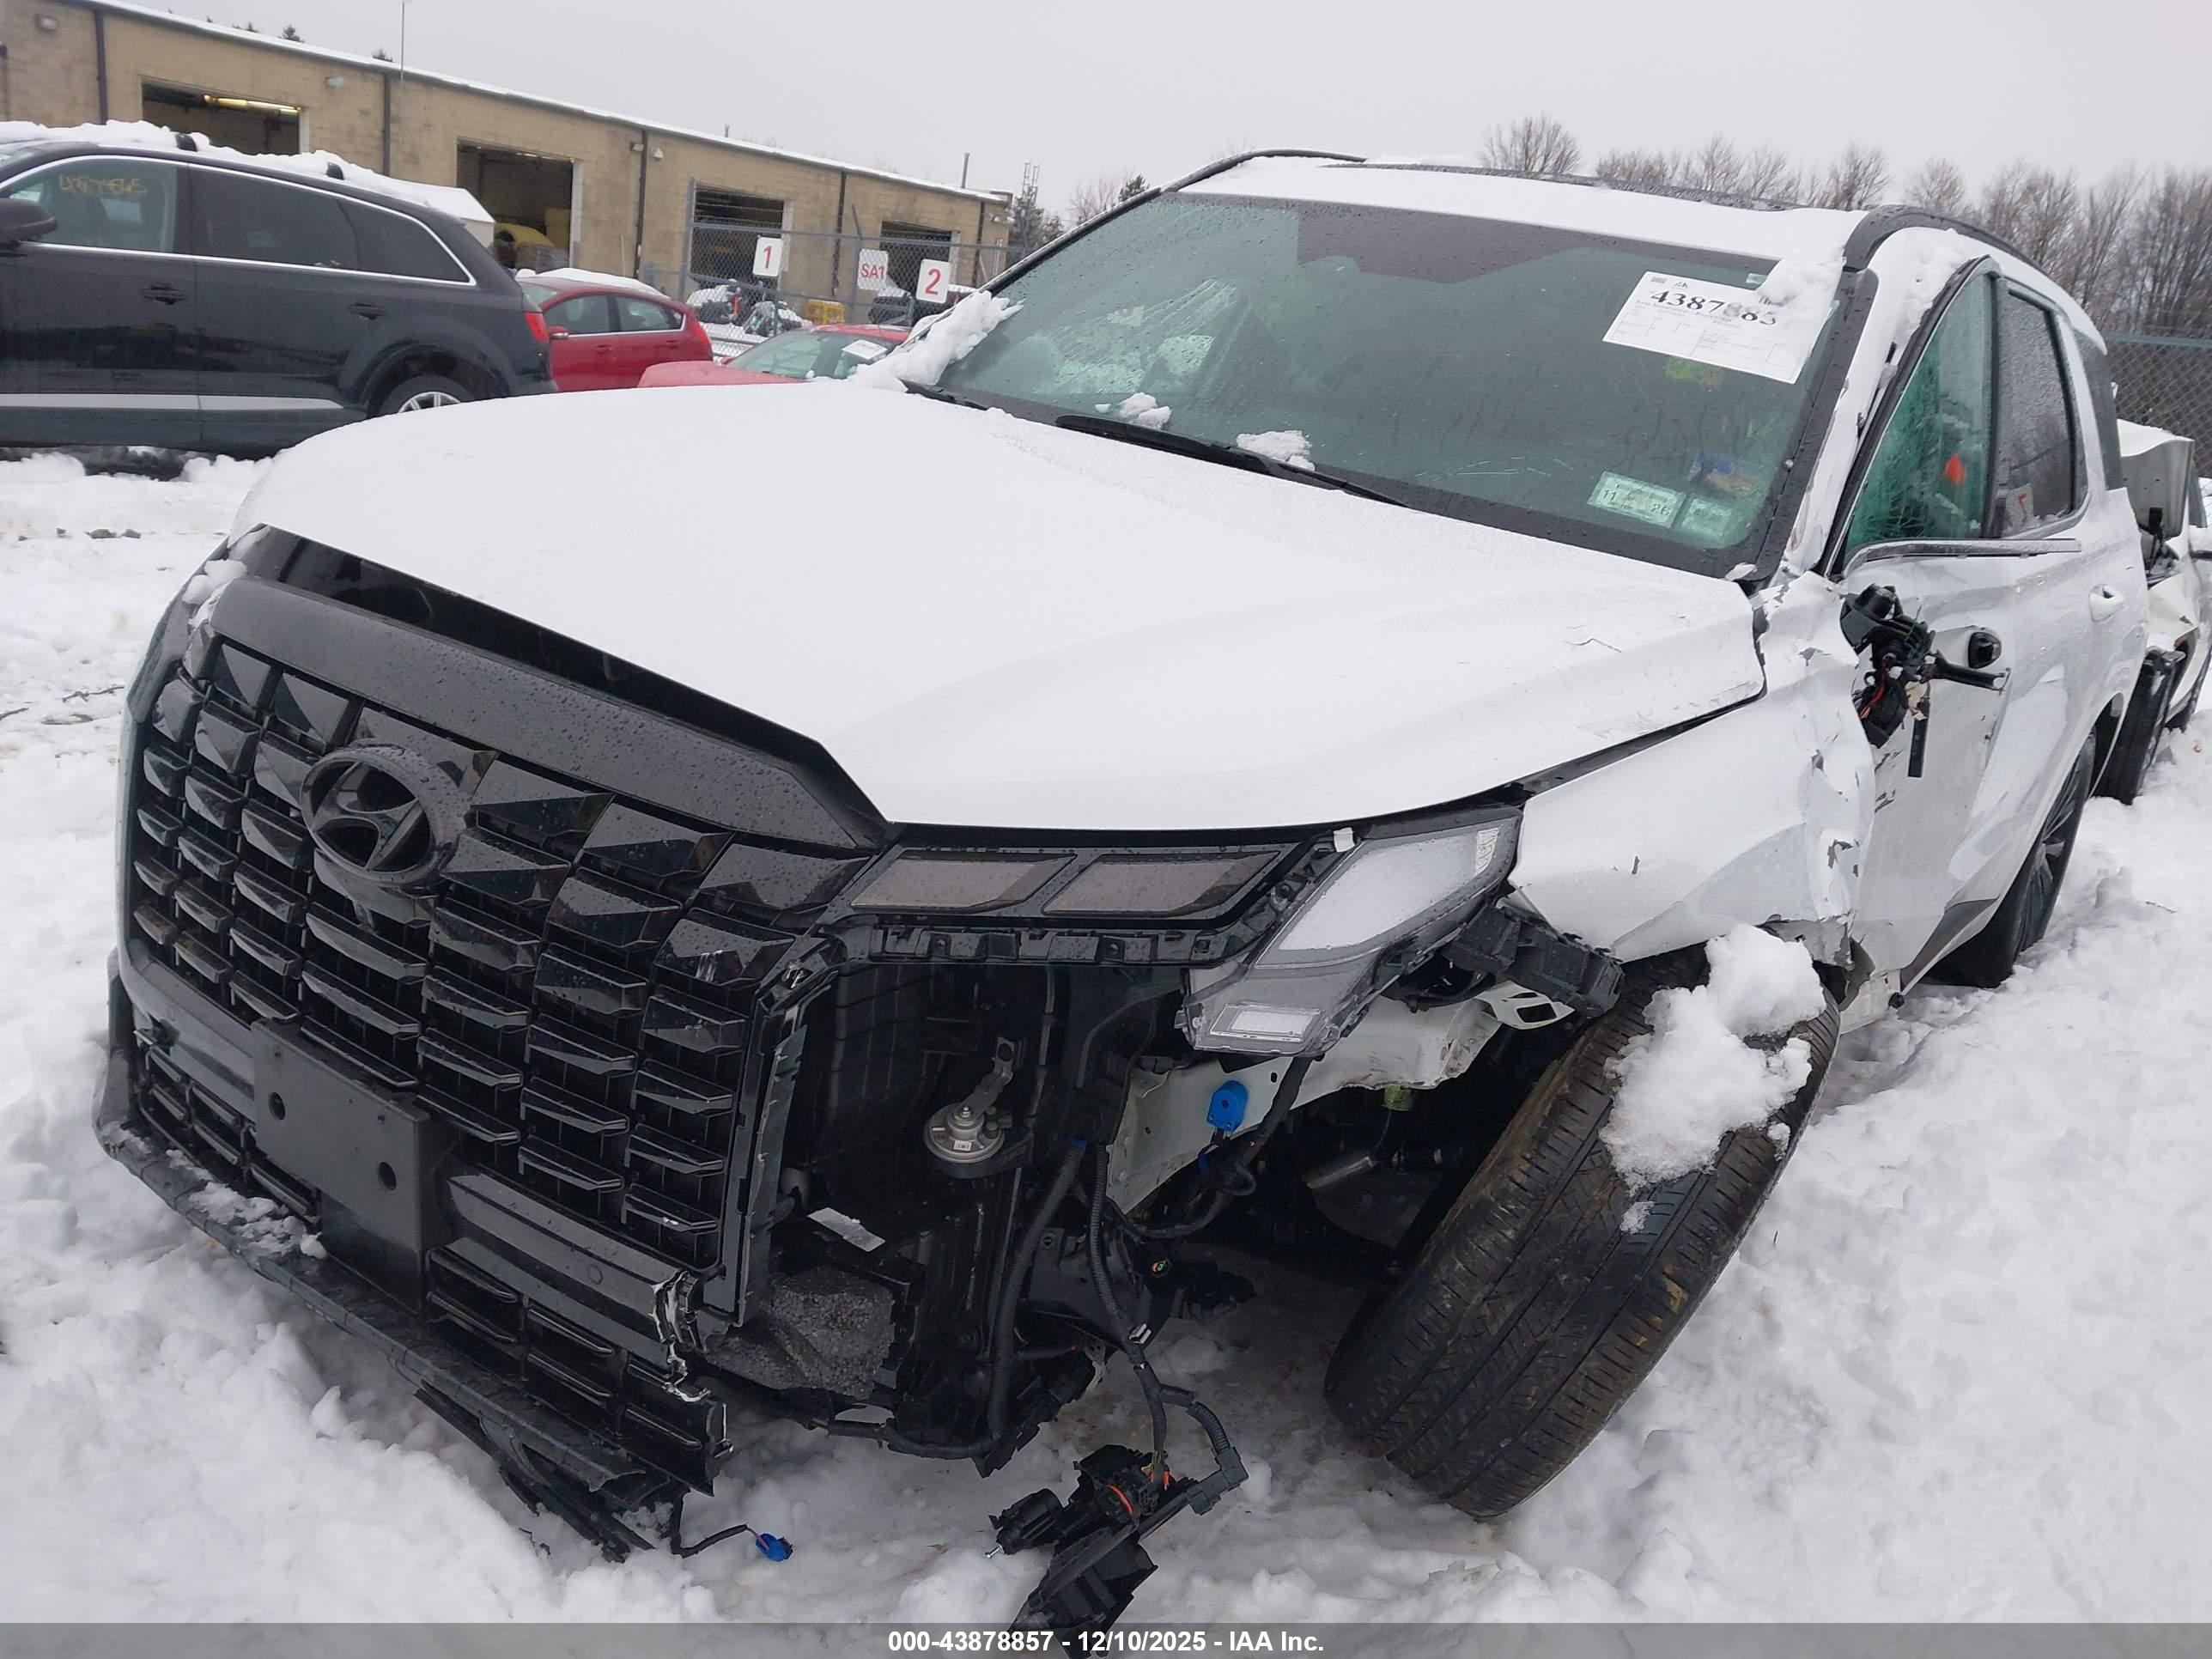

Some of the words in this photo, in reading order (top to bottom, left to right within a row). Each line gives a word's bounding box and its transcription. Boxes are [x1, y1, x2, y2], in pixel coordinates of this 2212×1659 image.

[763, 246, 773, 270] 1
[860, 263, 885, 281] SA1
[925, 268, 942, 295] 2
